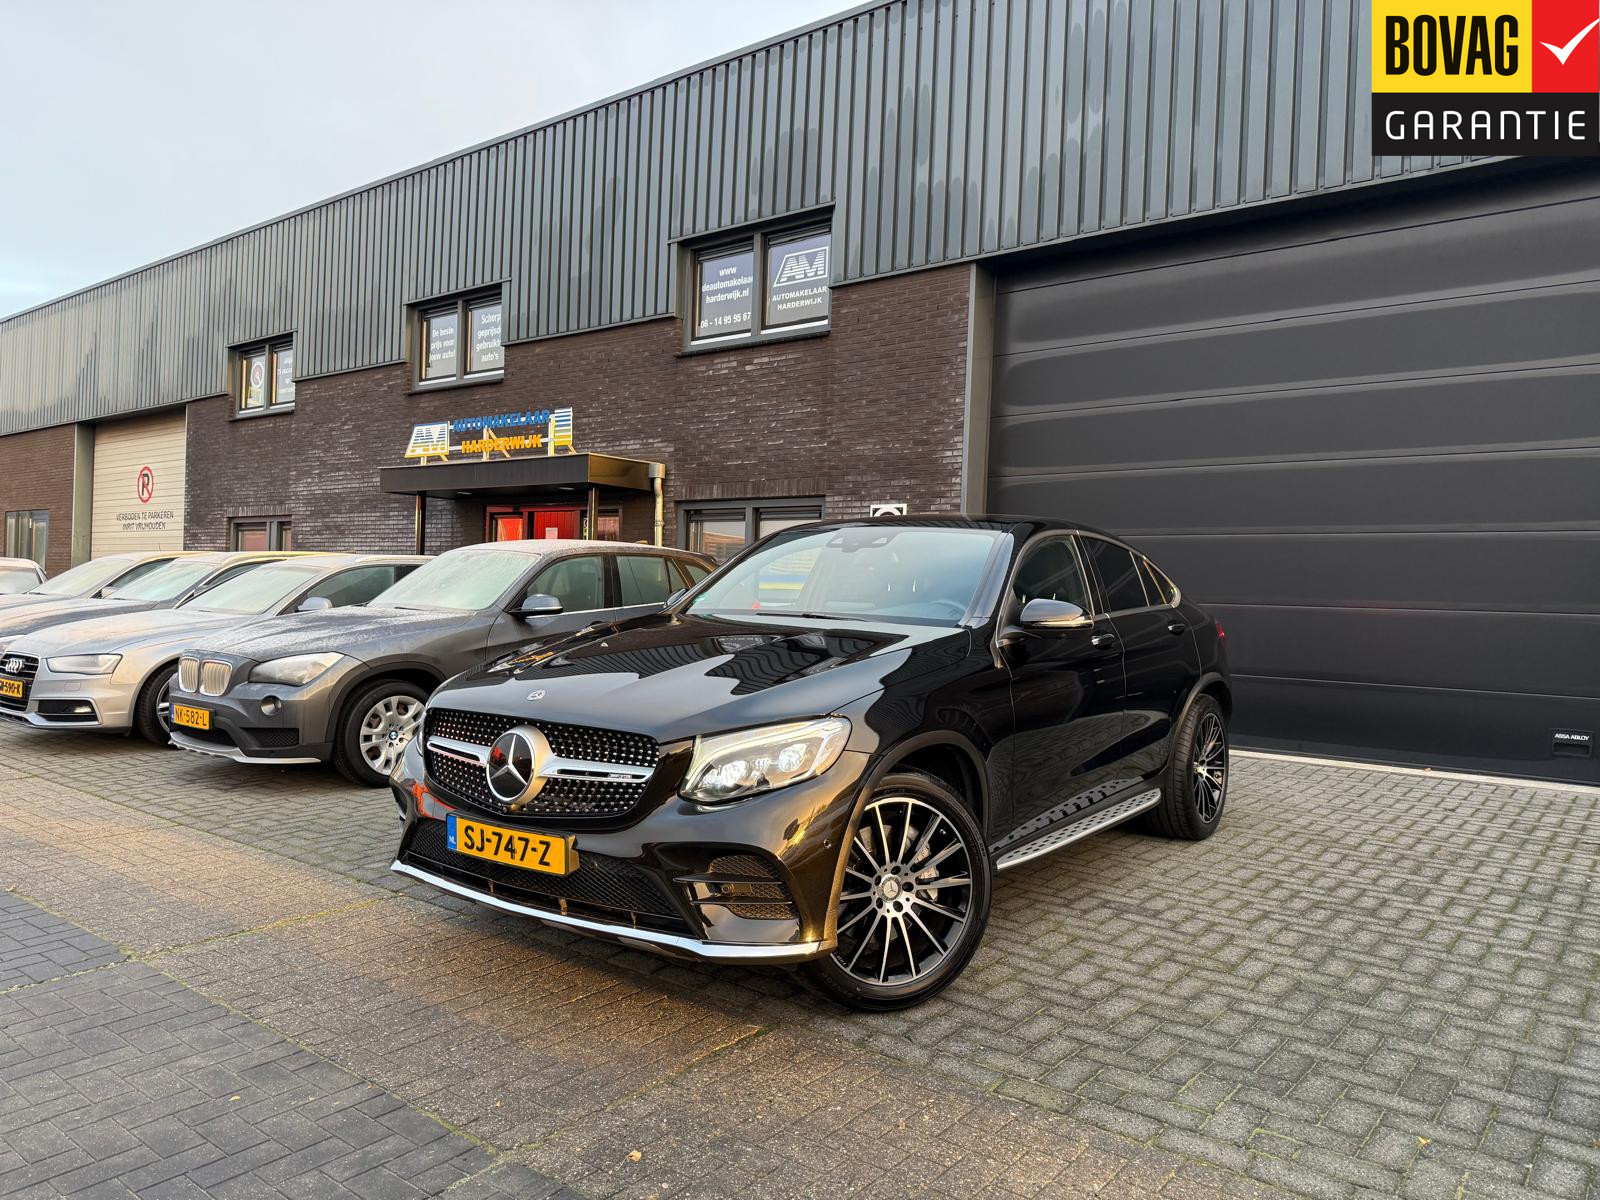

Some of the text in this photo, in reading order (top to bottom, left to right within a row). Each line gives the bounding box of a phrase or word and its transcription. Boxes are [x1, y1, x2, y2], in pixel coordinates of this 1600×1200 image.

[706, 288, 749, 304] harderwijk.nl
[772, 285, 828, 301] AUTOMAKELAAR
[777, 297, 822, 310] HARDERWIJK
[714, 316, 722, 326] 14
[452, 409, 551, 433] AUTOMAKELAAR
[461, 433, 543, 454] HARDERWIJK
[116, 511, 174, 521] VERBODEN TE PARKEREN
[175, 707, 207, 726] NK-582-L
[464, 825, 552, 867] SJ-747-Z
